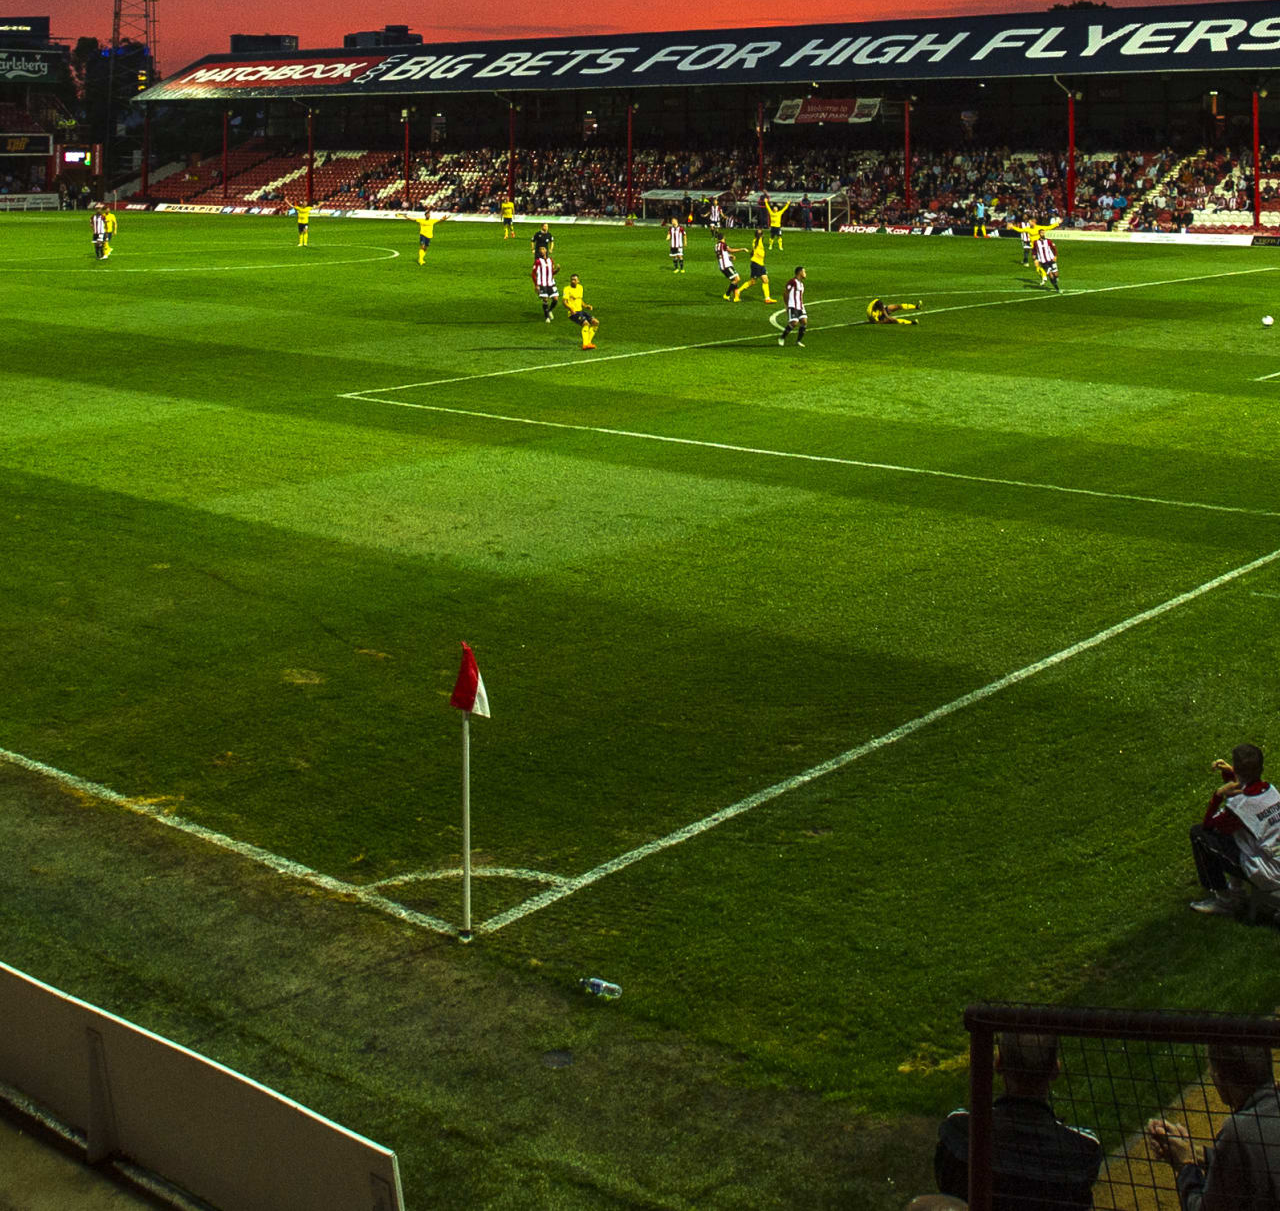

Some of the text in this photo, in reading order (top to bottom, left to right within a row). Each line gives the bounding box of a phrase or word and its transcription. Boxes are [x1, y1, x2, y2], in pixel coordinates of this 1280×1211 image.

[180, 62, 368, 84] MATCHBOOK
[379, 53, 487, 82] BIG
[472, 47, 641, 78] BETS
[632, 41, 783, 74] FOR
[779, 31, 970, 68] HIGH
